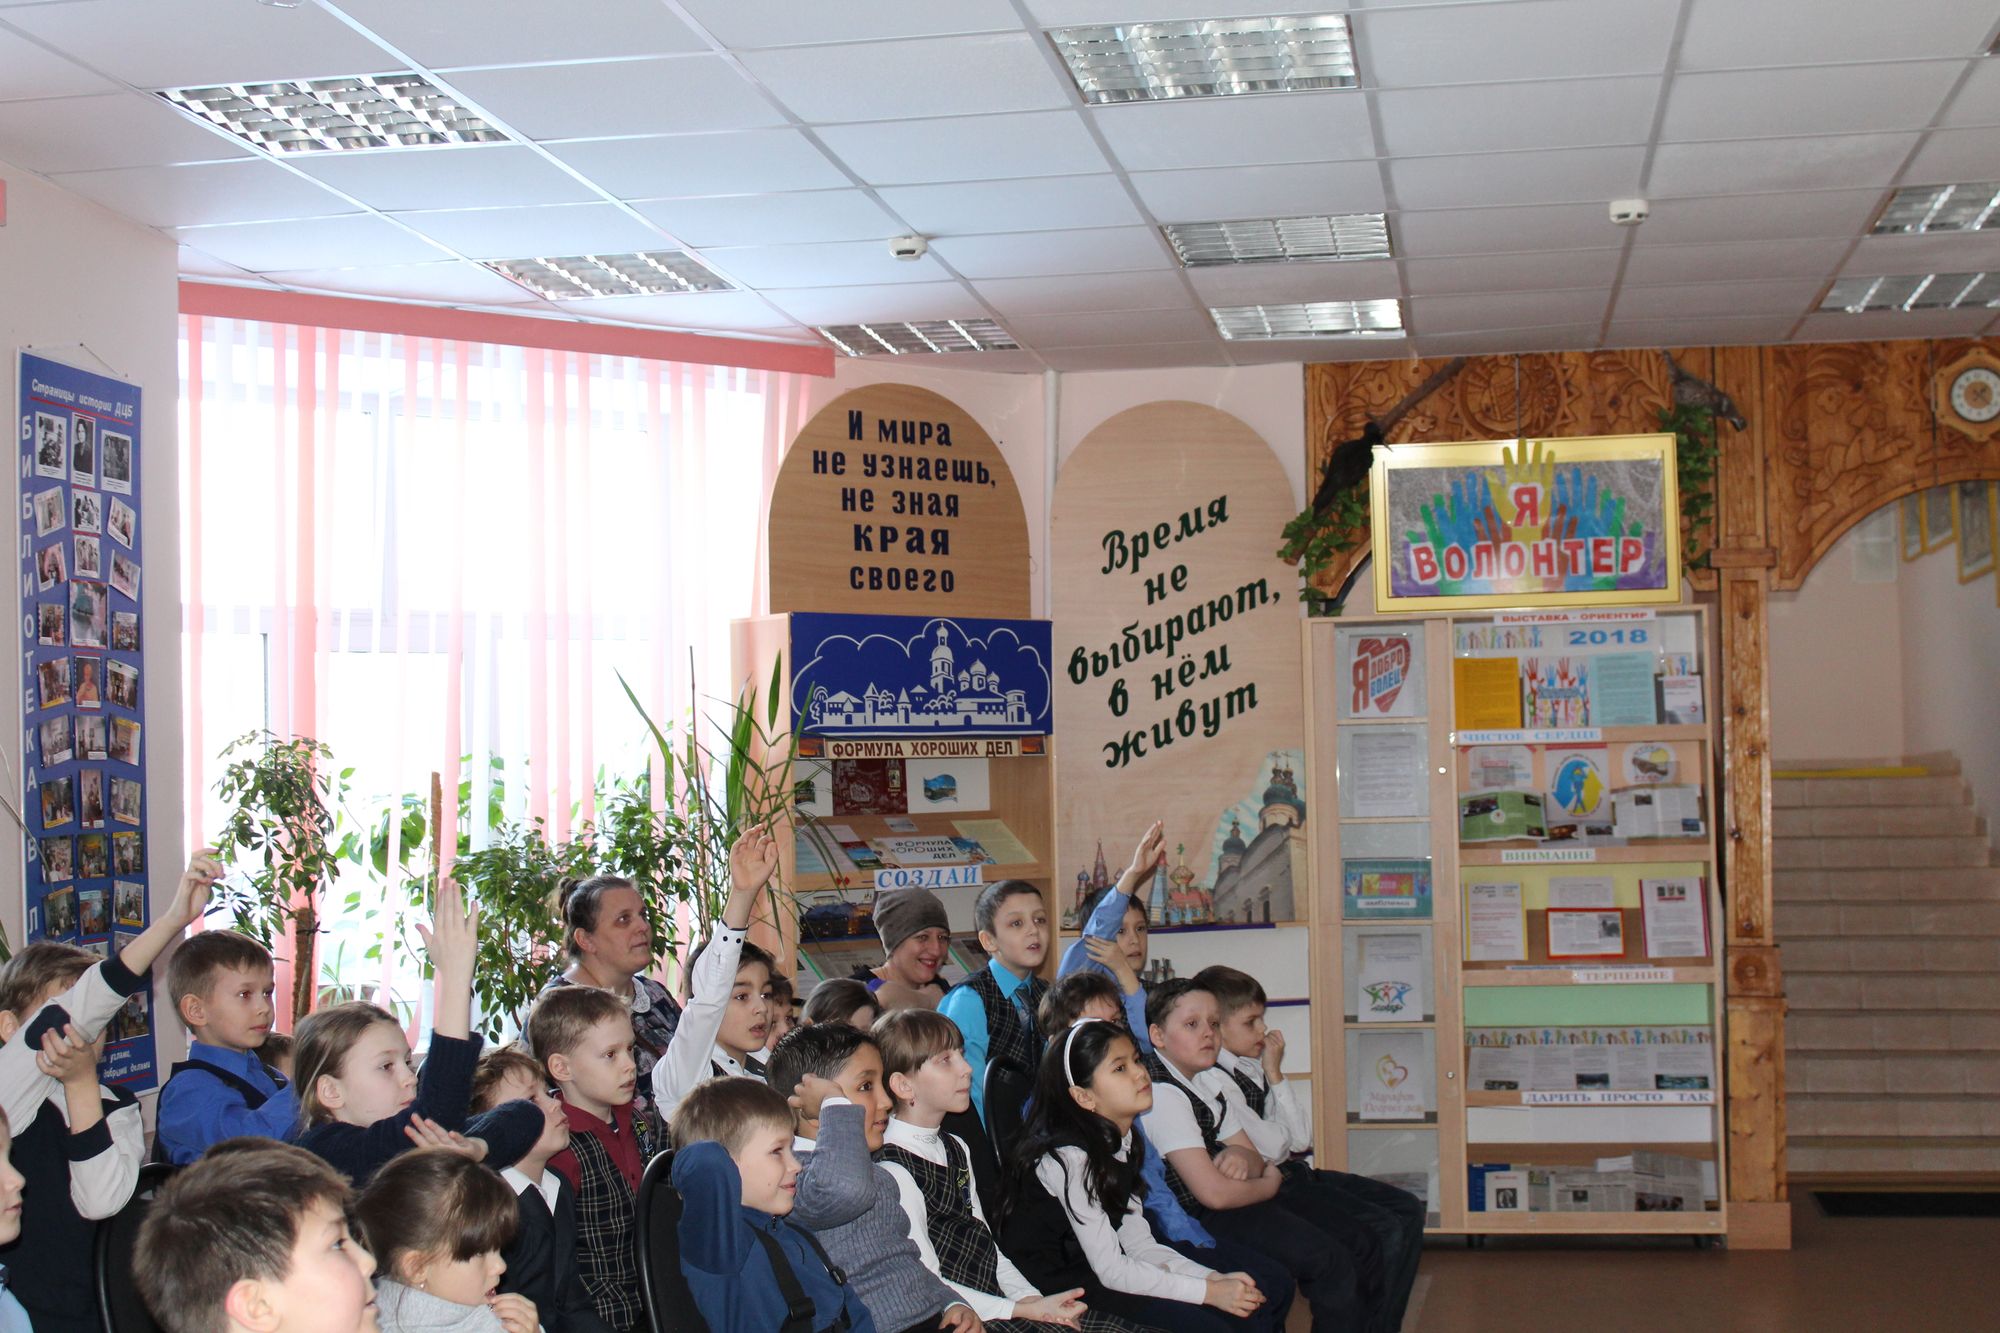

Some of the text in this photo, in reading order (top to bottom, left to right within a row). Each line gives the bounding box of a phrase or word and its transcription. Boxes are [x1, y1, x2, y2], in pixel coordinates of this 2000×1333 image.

[31, 378, 134, 419] Страницы истории ДЦБ
[848, 410, 952, 446] И мира
[812, 450, 996, 488] не узнаешь,
[841, 488, 959, 518] не зная
[1513, 487, 1538, 527] Я
[853, 523, 950, 556] края
[1101, 495, 1229, 575] Время
[1412, 538, 1644, 581] ВОЛОНТЕР
[850, 566, 955, 592] своего
[1144, 564, 1188, 606] не
[22, 415, 38, 793] БИБЛИОТЕКА
[1502, 614, 1569, 623] ВЫСТАВКА
[1580, 612, 1648, 620] ОРИЕНТИР
[1067, 578, 1281, 685] выбирают,
[1569, 629, 1648, 646] 2018
[1370, 648, 1403, 680] ДОБРО
[1108, 644, 1232, 717] в нём
[1353, 656, 1369, 714] Я
[1102, 682, 1259, 768] живут
[1463, 730, 1599, 742] ЧИСТОЕ СЕРДЦЕ
[832, 741, 1013, 758] ФОРМУЛА ХОРОШИХ ДЕЛ
[895, 839, 953, 847] ФОРМУЛА
[1504, 850, 1594, 862] ВНИМАНИЕ
[877, 865, 979, 889] СОЗДАЙ
[1584, 970, 1670, 982] ТЕРПЕНИЕ
[103, 1066, 128, 1079] добрыми
[1525, 1092, 1710, 1103] ДАРИТЬ ПРОСТО ТАК
